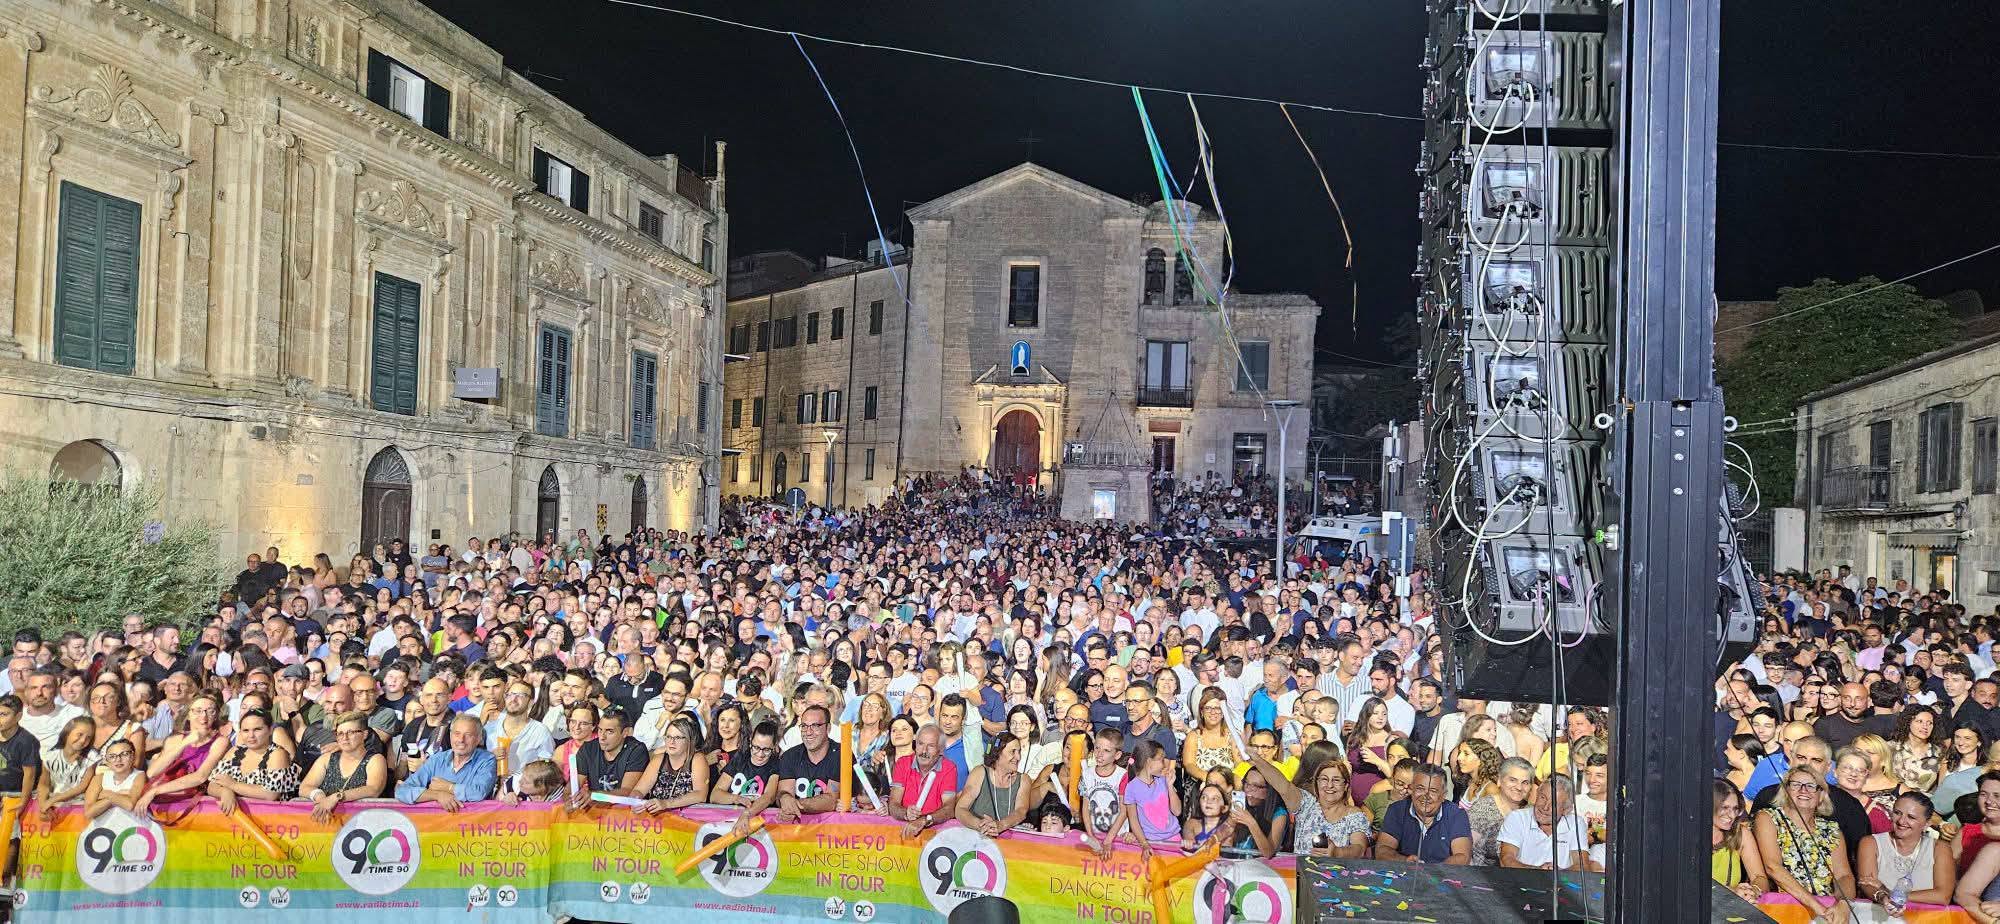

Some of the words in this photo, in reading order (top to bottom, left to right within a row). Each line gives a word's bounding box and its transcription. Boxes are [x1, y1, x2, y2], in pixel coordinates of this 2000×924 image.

[231, 824, 300, 840] TIE90
[458, 821, 528, 838] TIME90
[597, 815, 663, 835] TIME90
[84, 826, 158, 874] 90
[342, 828, 411, 875] 90
[431, 841, 493, 859] DANCE
[500, 840, 550, 859] SHOW
[568, 834, 627, 854] DANCE
[632, 837, 688, 857] SHOW
[816, 833, 886, 852] TIME90
[112, 864, 137, 873] TIME
[140, 864, 154, 873] 90
[231, 864, 246, 880] IN
[255, 864, 298, 880] TOUR
[368, 866, 393, 874] TIME
[396, 865, 409, 873] 90
[459, 862, 475, 877] IN
[482, 862, 527, 878] TOUR
[592, 857, 607, 873] IN
[615, 857, 661, 876] TOUR
[789, 852, 850, 869] DANCE
[857, 854, 911, 873] SHOW
[928, 846, 998, 895] 90
[728, 869, 752, 878] TIME
[754, 870, 768, 878] 90
[816, 871, 832, 887] IN
[839, 873, 885, 893] TOUR
[953, 889, 977, 900] TIME
[1050, 877, 1114, 901] DANCE
[695, 902, 777, 914] www.radiotime.it
[855, 905, 873, 917] 90
[1077, 902, 1095, 920] IN
[1101, 904, 1152, 924] TOUR
